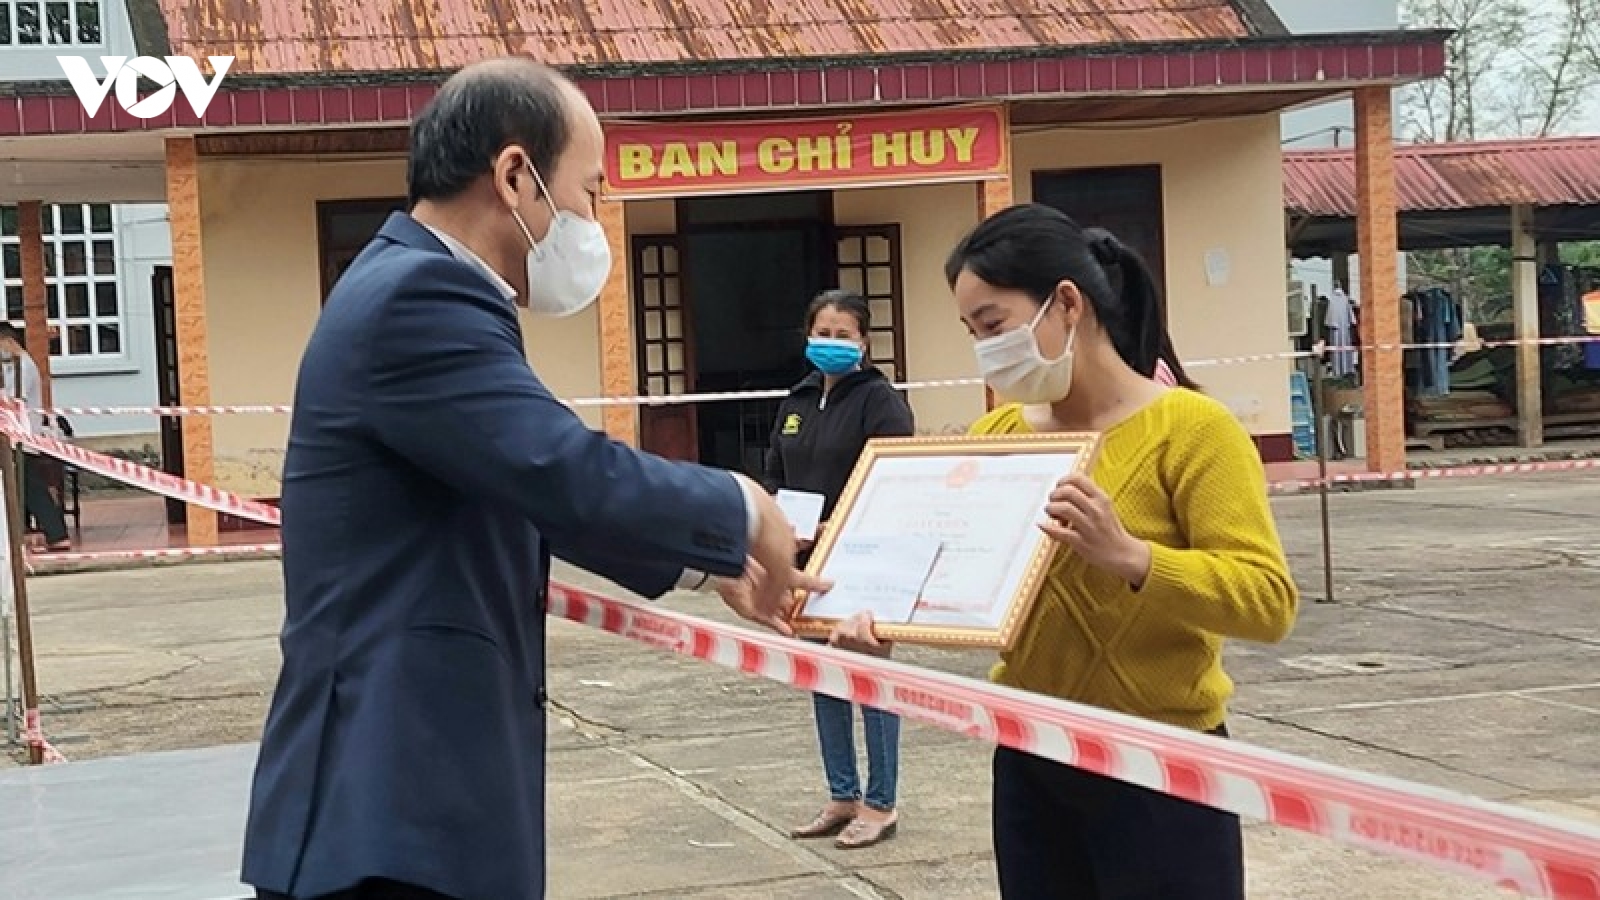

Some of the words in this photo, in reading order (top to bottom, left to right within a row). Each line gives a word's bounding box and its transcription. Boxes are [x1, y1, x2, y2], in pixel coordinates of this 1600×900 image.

[619, 142, 738, 179] BAN
[757, 124, 852, 172] CHỈ
[872, 127, 979, 168] HUY
